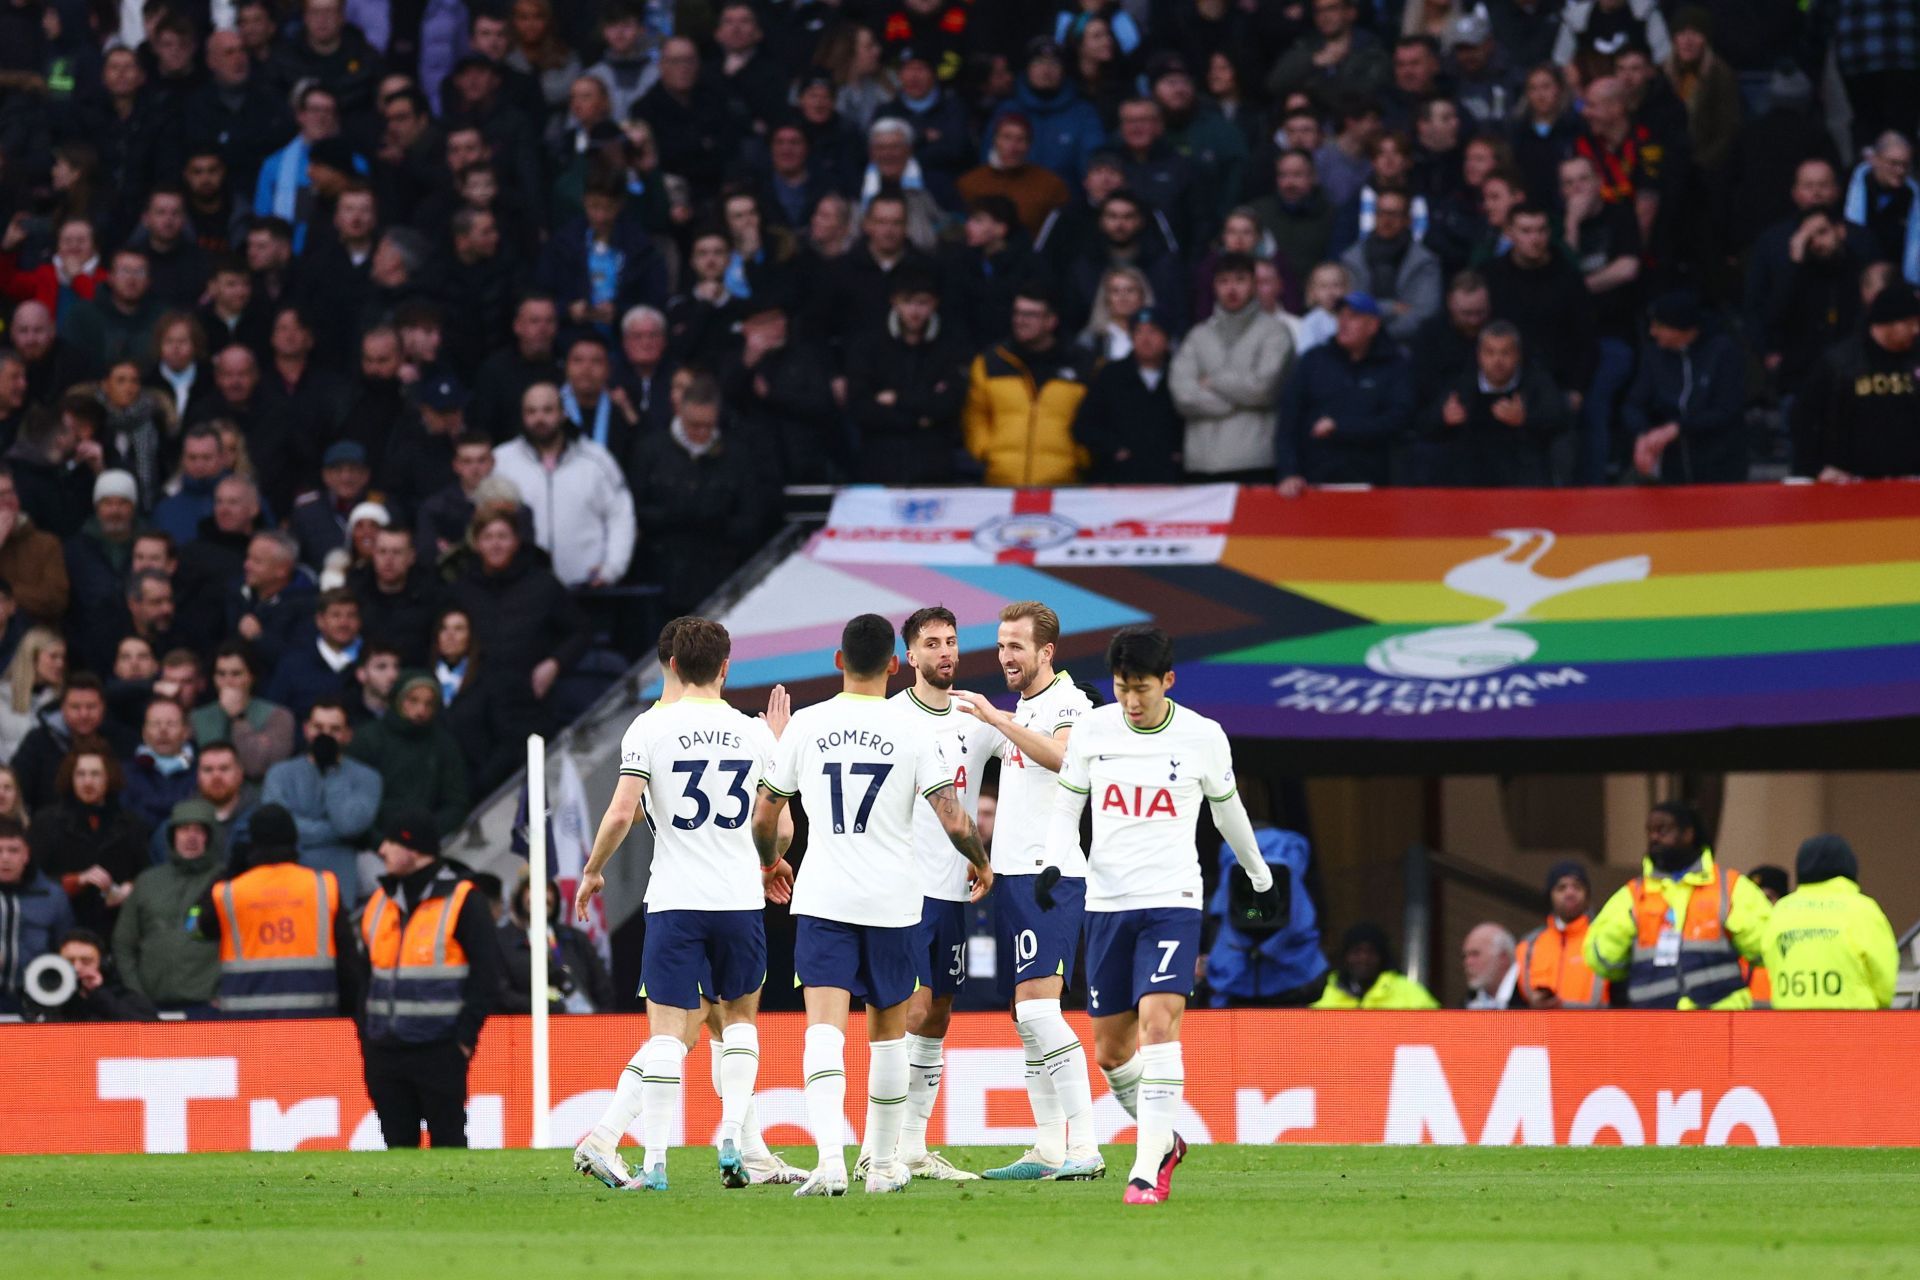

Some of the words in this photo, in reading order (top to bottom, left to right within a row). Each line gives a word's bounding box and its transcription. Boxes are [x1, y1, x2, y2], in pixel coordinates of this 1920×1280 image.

[1269, 667, 1589, 703] TOTTENHAM
[1275, 692, 1536, 715] HOTSPUR
[678, 730, 743, 750] DAVIES
[816, 729, 894, 756] ROMERO
[671, 759, 754, 831] 33
[822, 762, 895, 835] 17
[1102, 783, 1178, 818] AIA
[259, 916, 297, 945] 08
[1014, 929, 1038, 965] 10
[1157, 940, 1181, 974] 7
[1777, 970, 1843, 997] 0610
